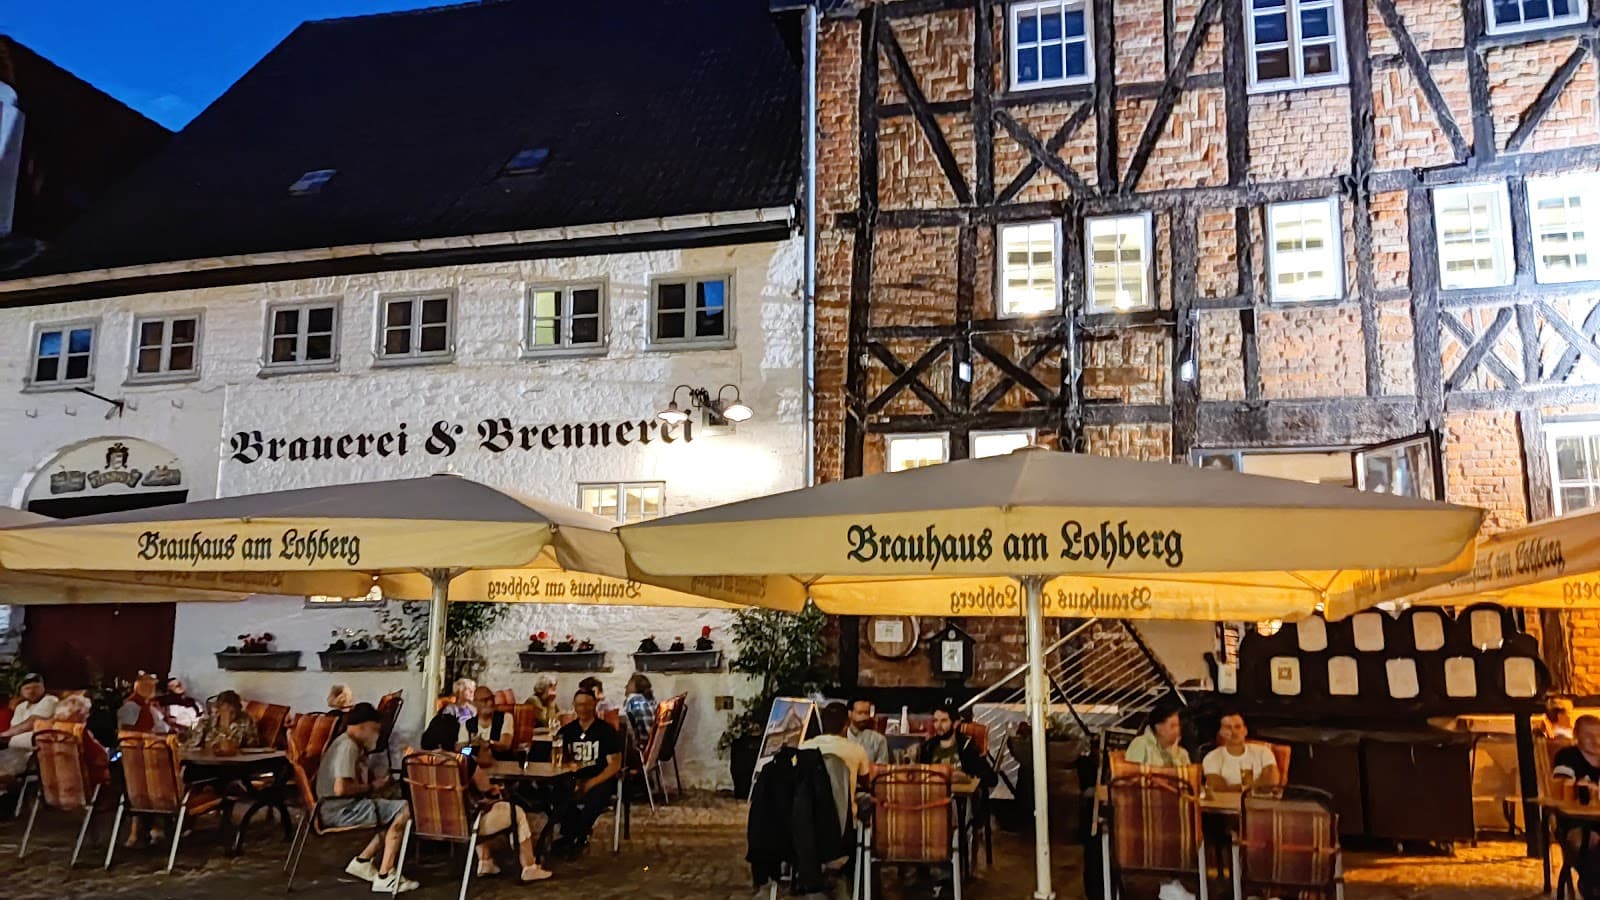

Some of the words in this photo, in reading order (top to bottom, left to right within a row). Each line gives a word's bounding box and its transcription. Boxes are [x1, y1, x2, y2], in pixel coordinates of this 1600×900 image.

[230, 423, 407, 464] Brauerei
[425, 420, 463, 457] &
[477, 409, 693, 453] Brennerei
[137, 530, 238, 567] Brauhaus
[241, 535, 272, 560] am
[278, 528, 361, 565] Lohberg
[847, 524, 993, 571] Brauhaus
[1003, 530, 1049, 562] am
[1060, 520, 1184, 568] Lohberg
[572, 740, 600, 761] 501
